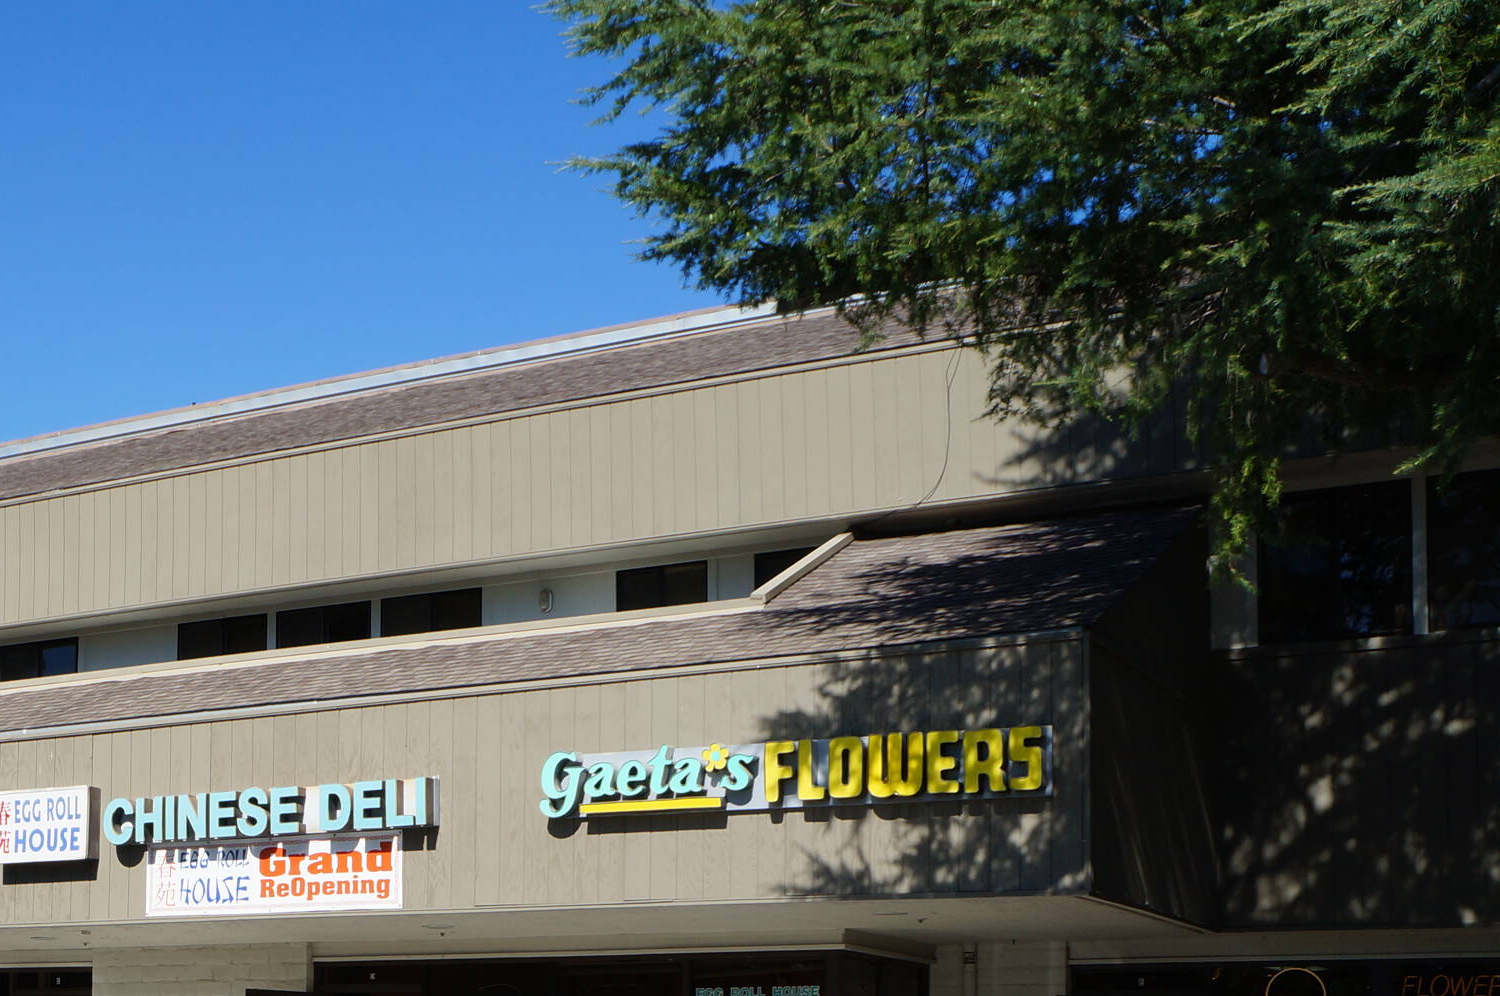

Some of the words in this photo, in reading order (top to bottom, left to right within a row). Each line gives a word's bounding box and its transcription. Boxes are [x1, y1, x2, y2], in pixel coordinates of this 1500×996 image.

[764, 725, 1044, 802] FLOWERS
[14, 799, 41, 824] EGG
[47, 795, 81, 822] ROLL
[102, 786, 300, 846] CHINESE
[318, 776, 428, 833] DELI
[14, 827, 81, 854] HOUSE
[180, 850, 209, 870] EGG
[216, 847, 250, 869] ROLL
[259, 841, 393, 877] Grand
[180, 876, 251, 905] HOUSE
[259, 875, 391, 901] ReOpening
